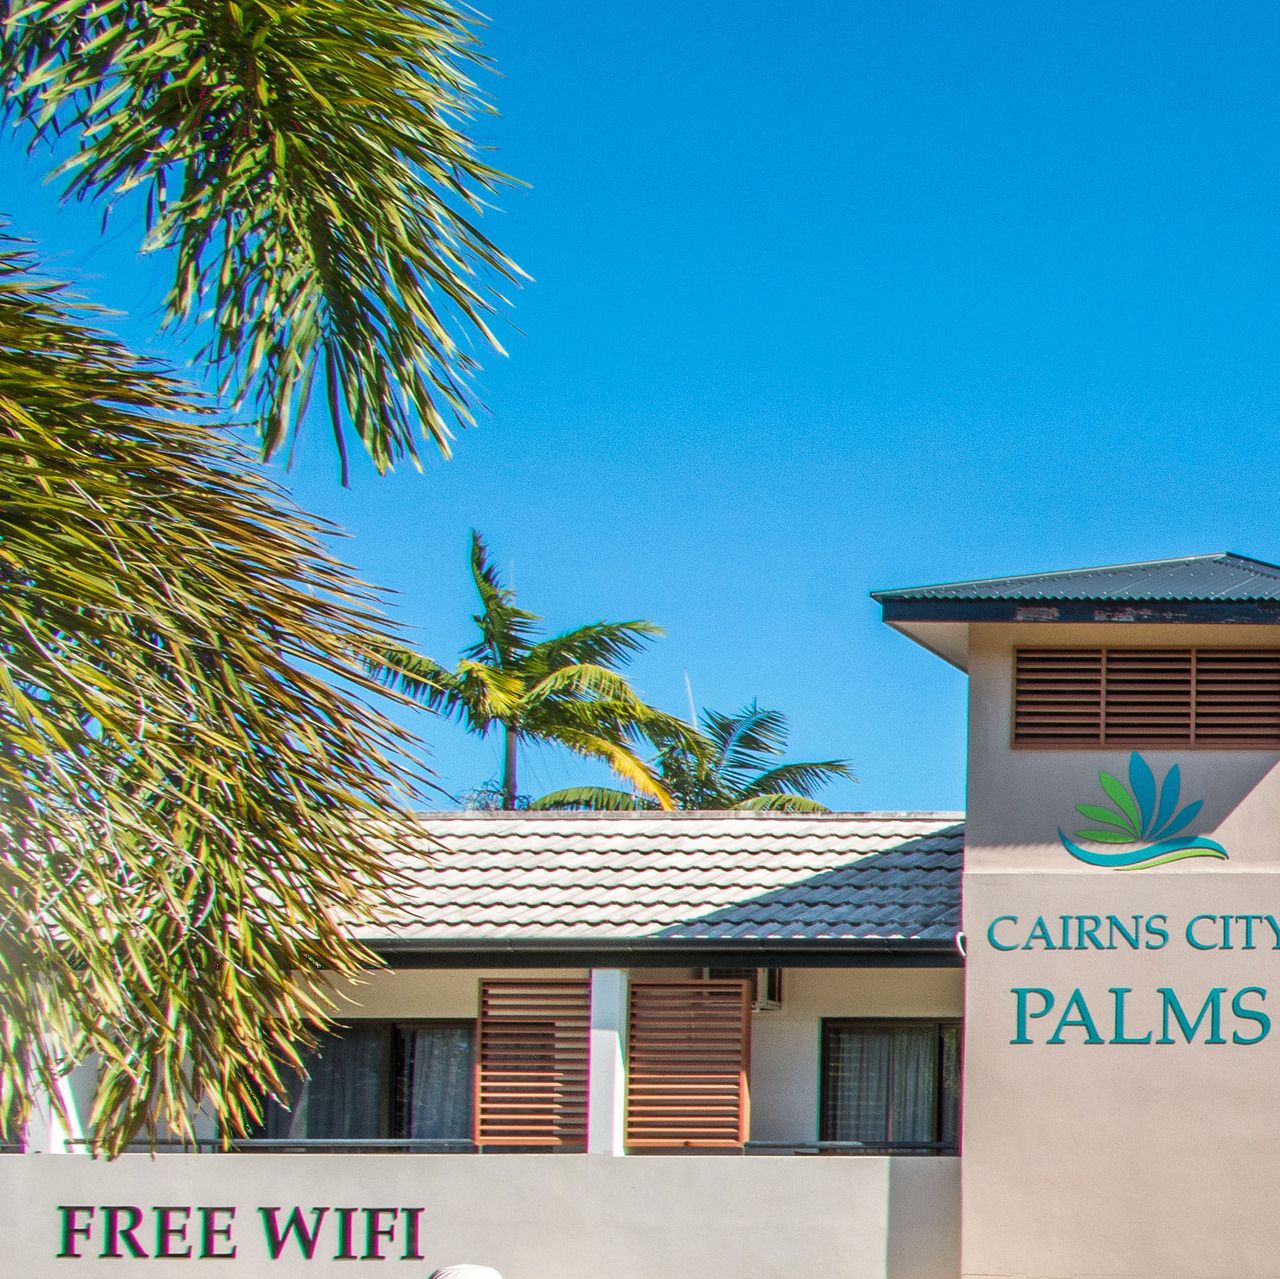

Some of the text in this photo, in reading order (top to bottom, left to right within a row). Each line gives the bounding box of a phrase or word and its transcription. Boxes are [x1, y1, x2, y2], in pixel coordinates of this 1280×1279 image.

[986, 914, 1169, 951] CAIRNS
[1009, 987, 1272, 1046] PALMS
[56, 1205, 426, 1261] FREE WIFI
